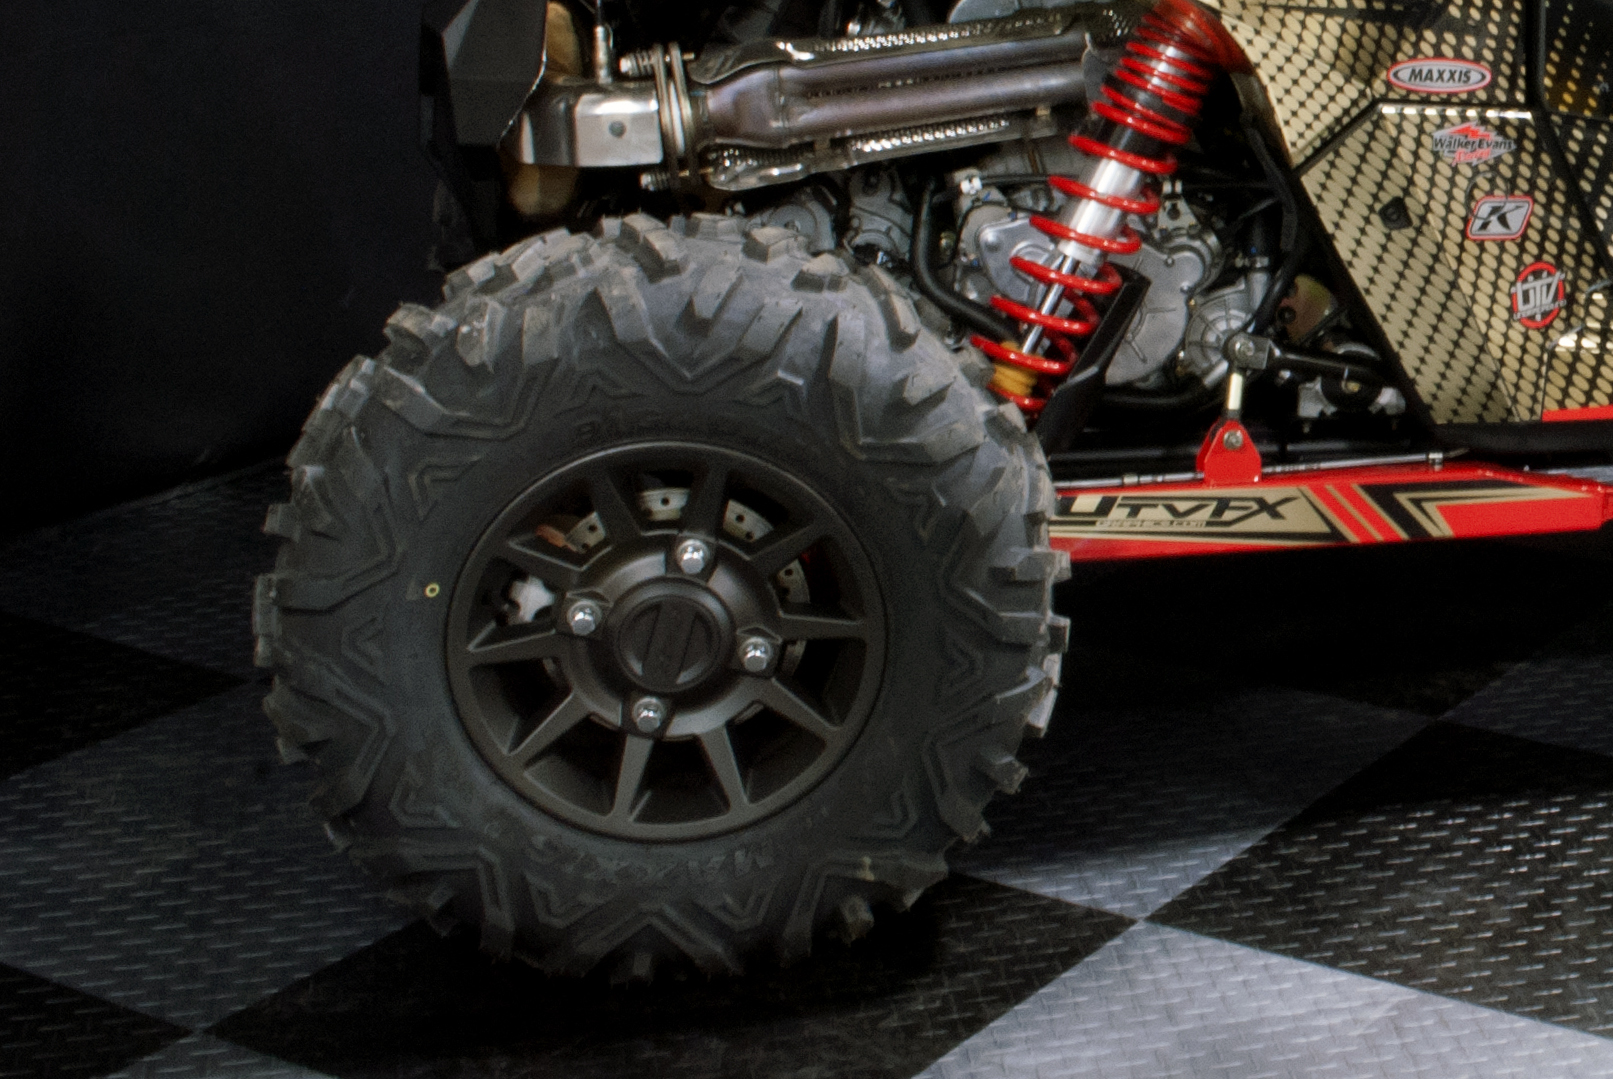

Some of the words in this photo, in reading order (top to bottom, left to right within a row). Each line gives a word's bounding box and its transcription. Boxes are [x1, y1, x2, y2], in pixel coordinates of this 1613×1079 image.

[1408, 65, 1472, 84] MAXXIS
[1433, 137, 1476, 150] Walker
[1478, 137, 1513, 151] Evans
[1055, 495, 1300, 521] UTVFX
